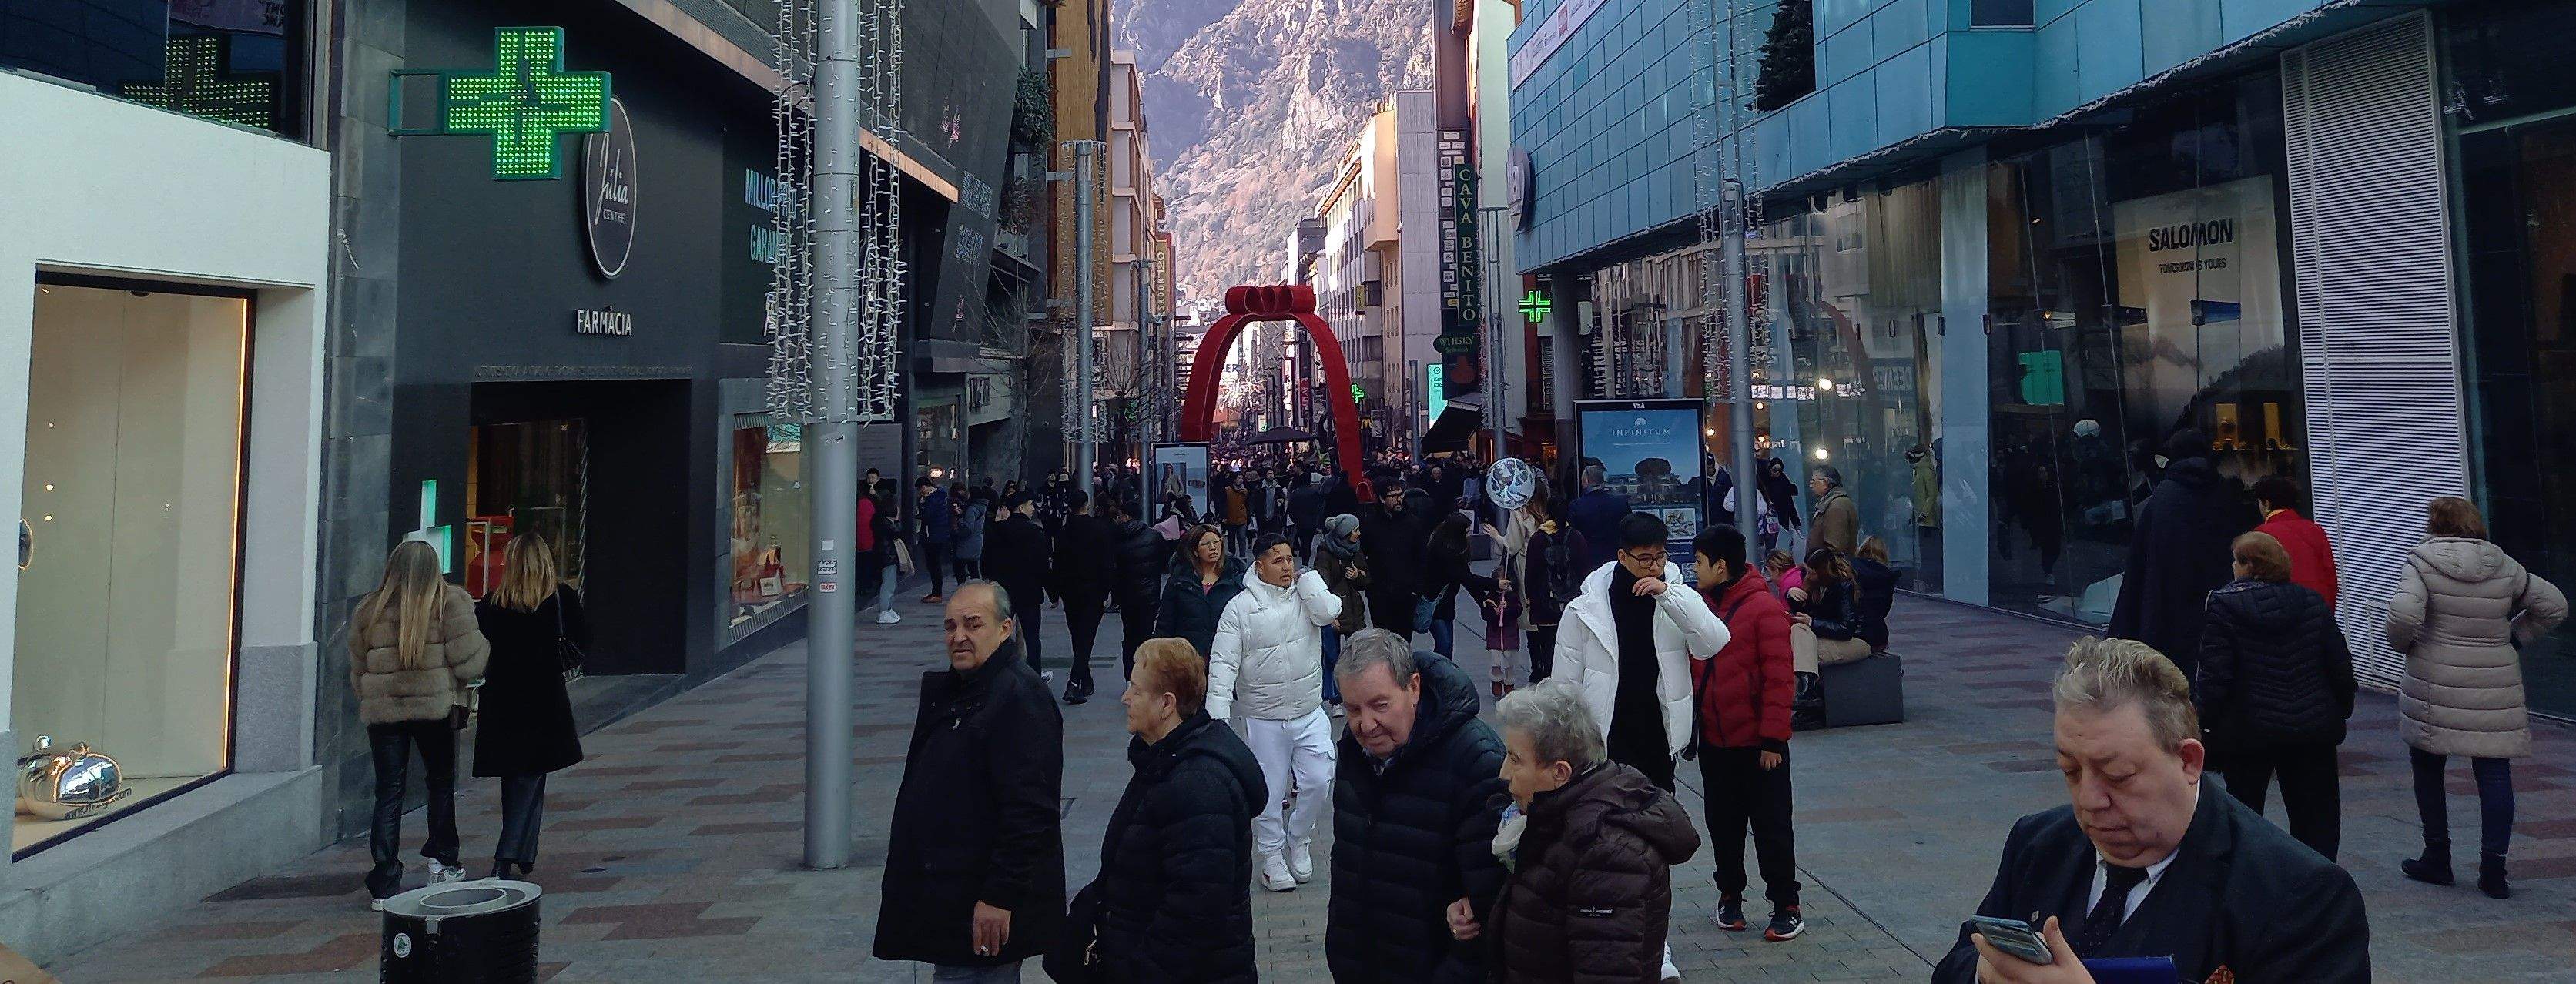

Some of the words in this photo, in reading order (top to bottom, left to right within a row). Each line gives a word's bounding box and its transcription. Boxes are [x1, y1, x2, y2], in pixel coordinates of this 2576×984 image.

[1459, 169, 1472, 224] CAVA
[2149, 219, 2233, 252] SALOMON
[1461, 236, 1476, 321] BENITO
[1439, 336, 1474, 346] WHISKY
[1611, 428, 1670, 437] INFINITUM
